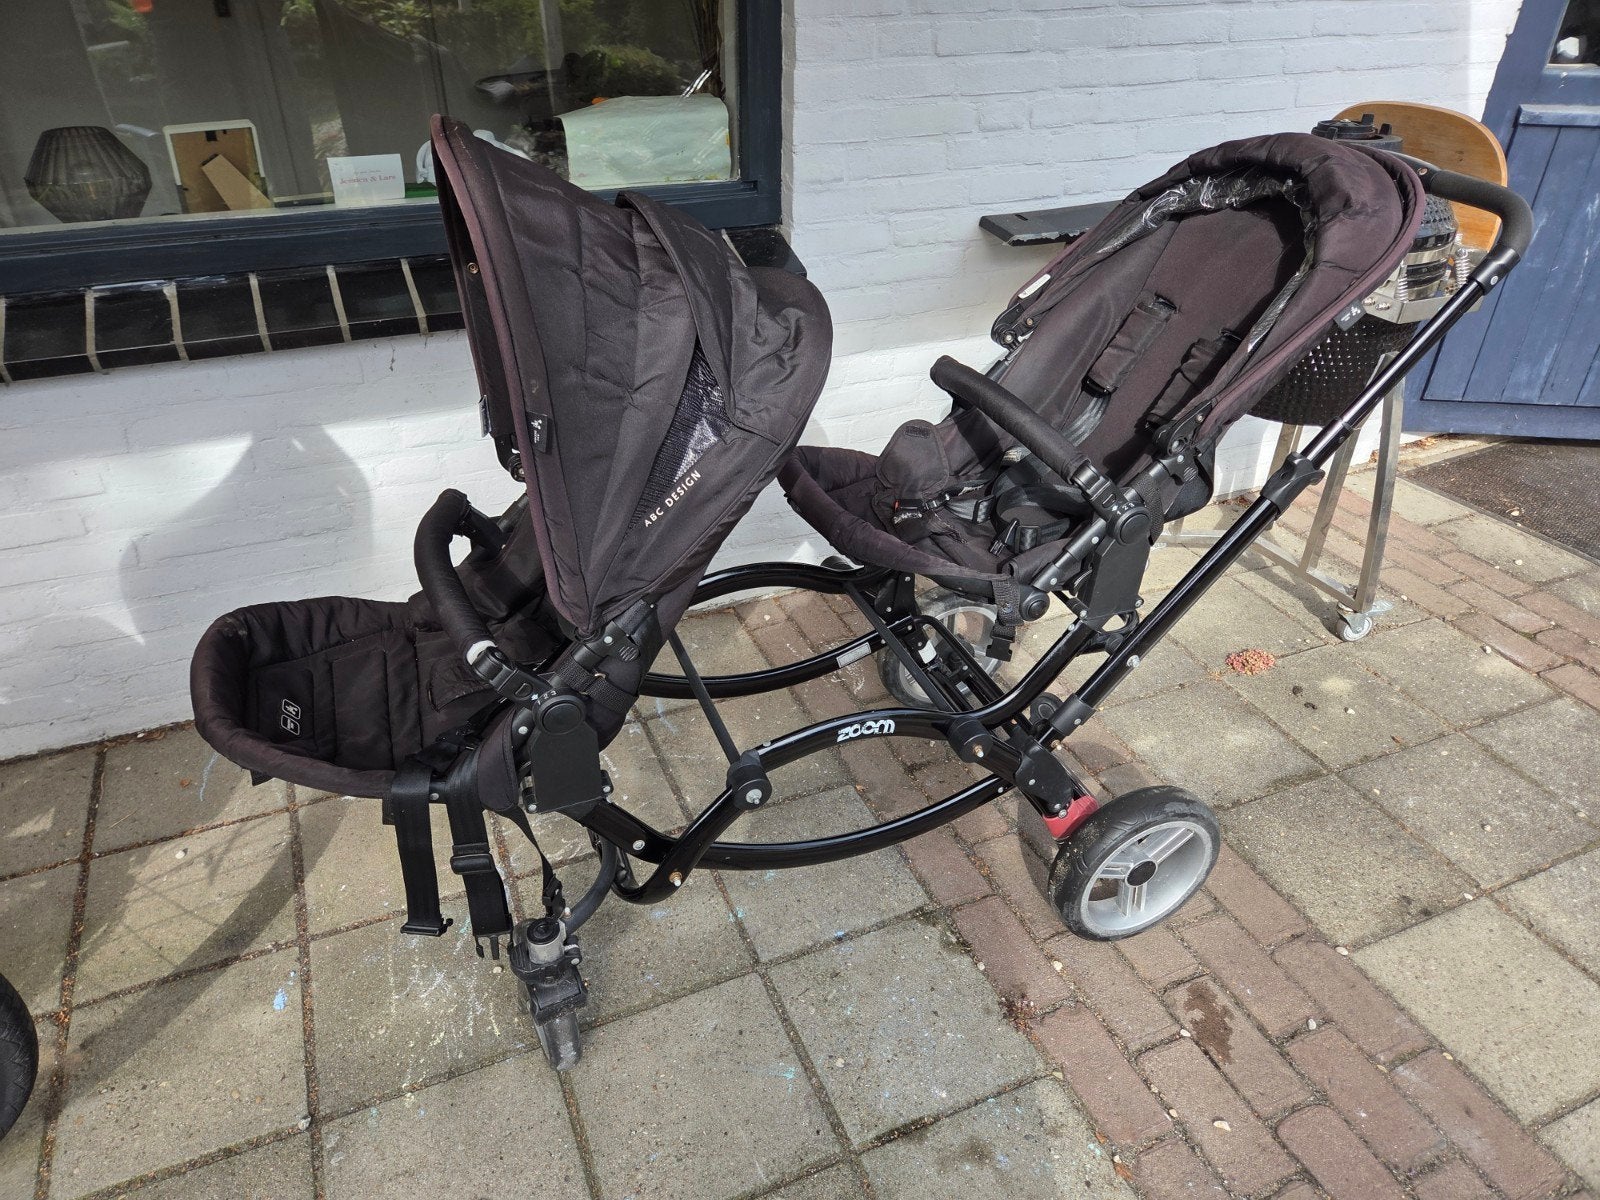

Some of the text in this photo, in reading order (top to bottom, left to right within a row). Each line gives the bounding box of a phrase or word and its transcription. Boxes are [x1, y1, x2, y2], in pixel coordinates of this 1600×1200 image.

[644, 470, 701, 527] ABC DESIGN
[837, 719, 895, 743] zoom
